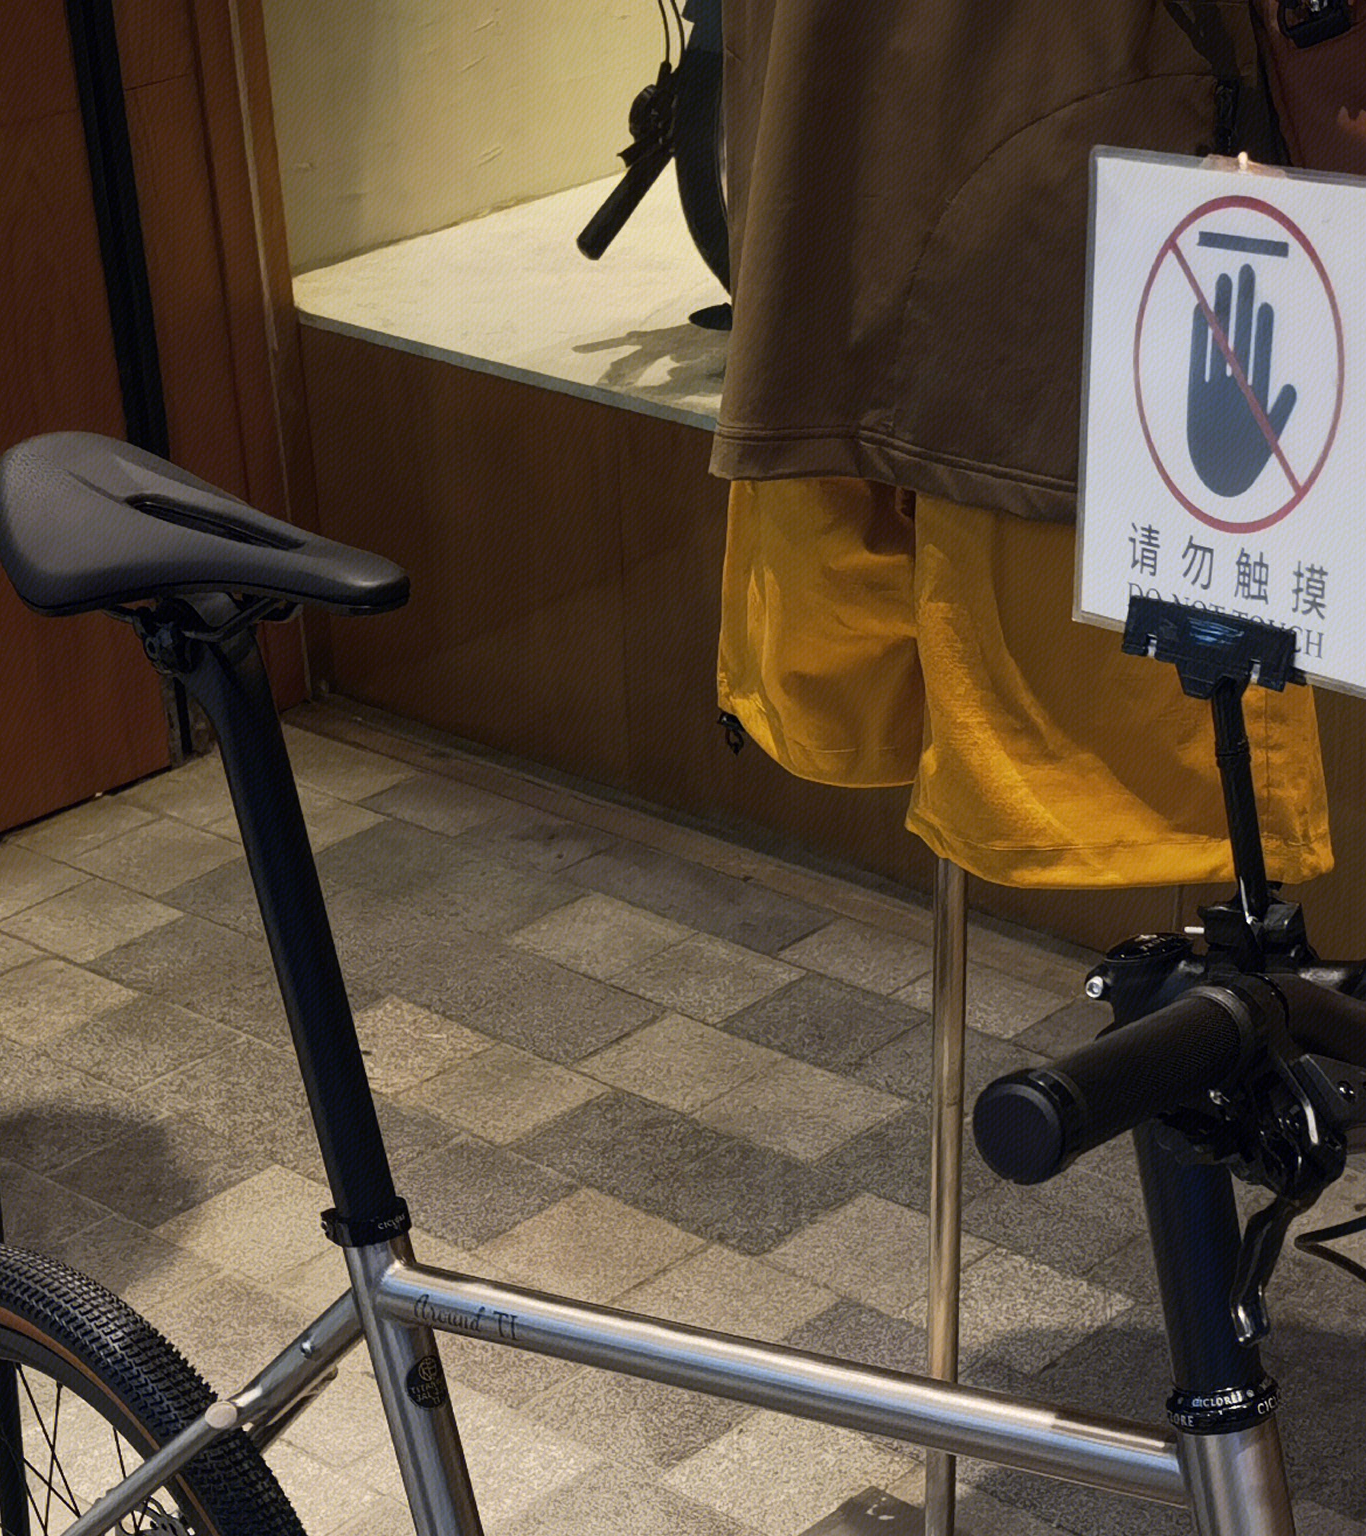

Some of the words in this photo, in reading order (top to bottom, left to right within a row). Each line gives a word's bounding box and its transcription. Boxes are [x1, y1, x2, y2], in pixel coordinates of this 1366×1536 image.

[1128, 522, 1329, 621] 请勿触摸
[414, 1293, 486, 1333] Around
[492, 1310, 518, 1341] TI
